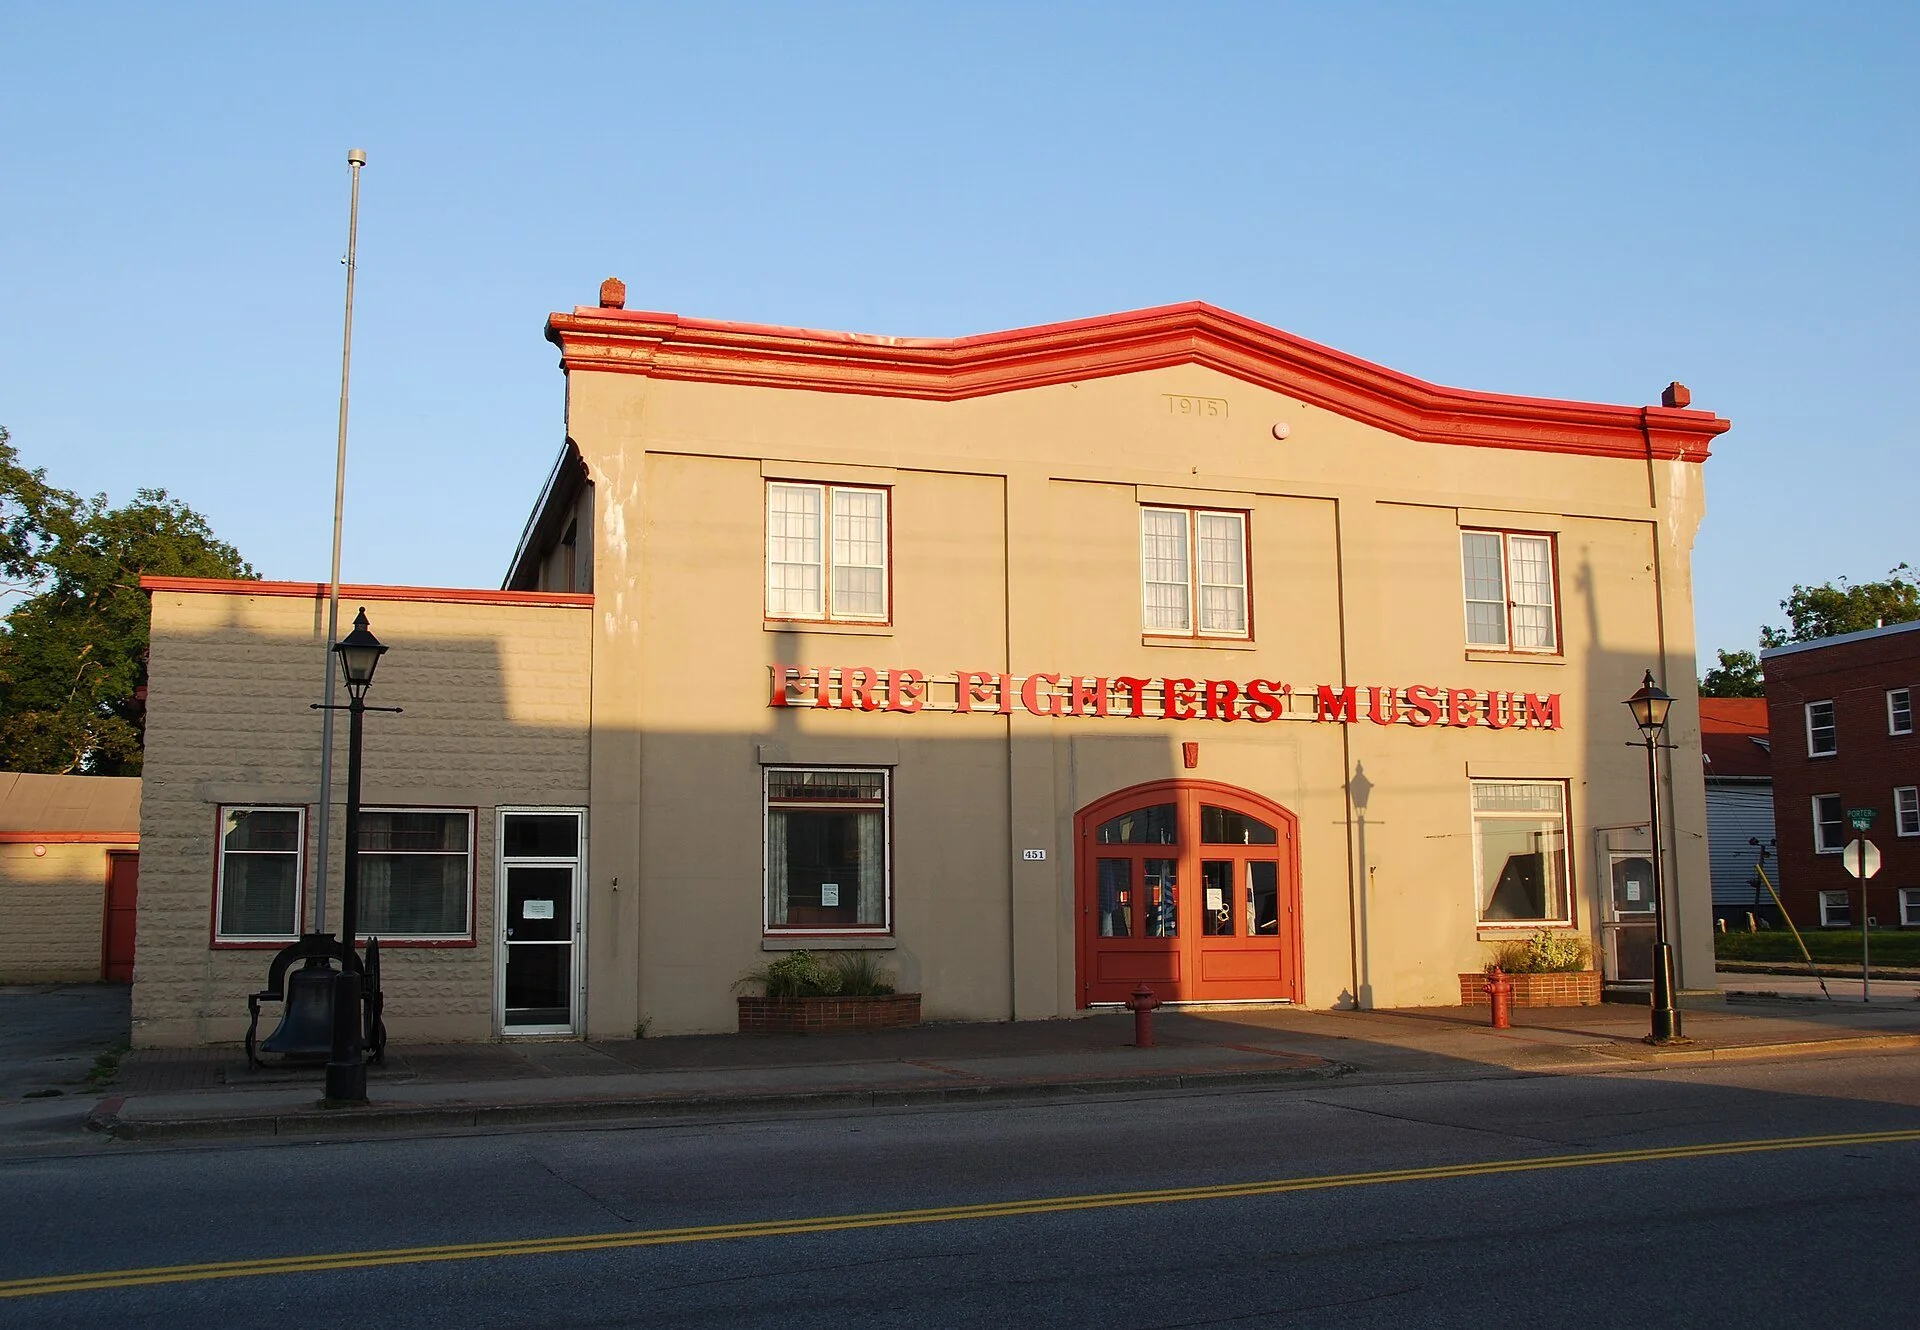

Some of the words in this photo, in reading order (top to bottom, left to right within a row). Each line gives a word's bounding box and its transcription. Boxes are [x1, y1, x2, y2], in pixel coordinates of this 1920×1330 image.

[1169, 397, 1218, 417] 1915
[768, 663, 923, 713] FIRE
[955, 671, 1291, 722] FIGHTERS'
[1316, 683, 1564, 731] MUSEUM
[1025, 851, 1044, 859] 451
